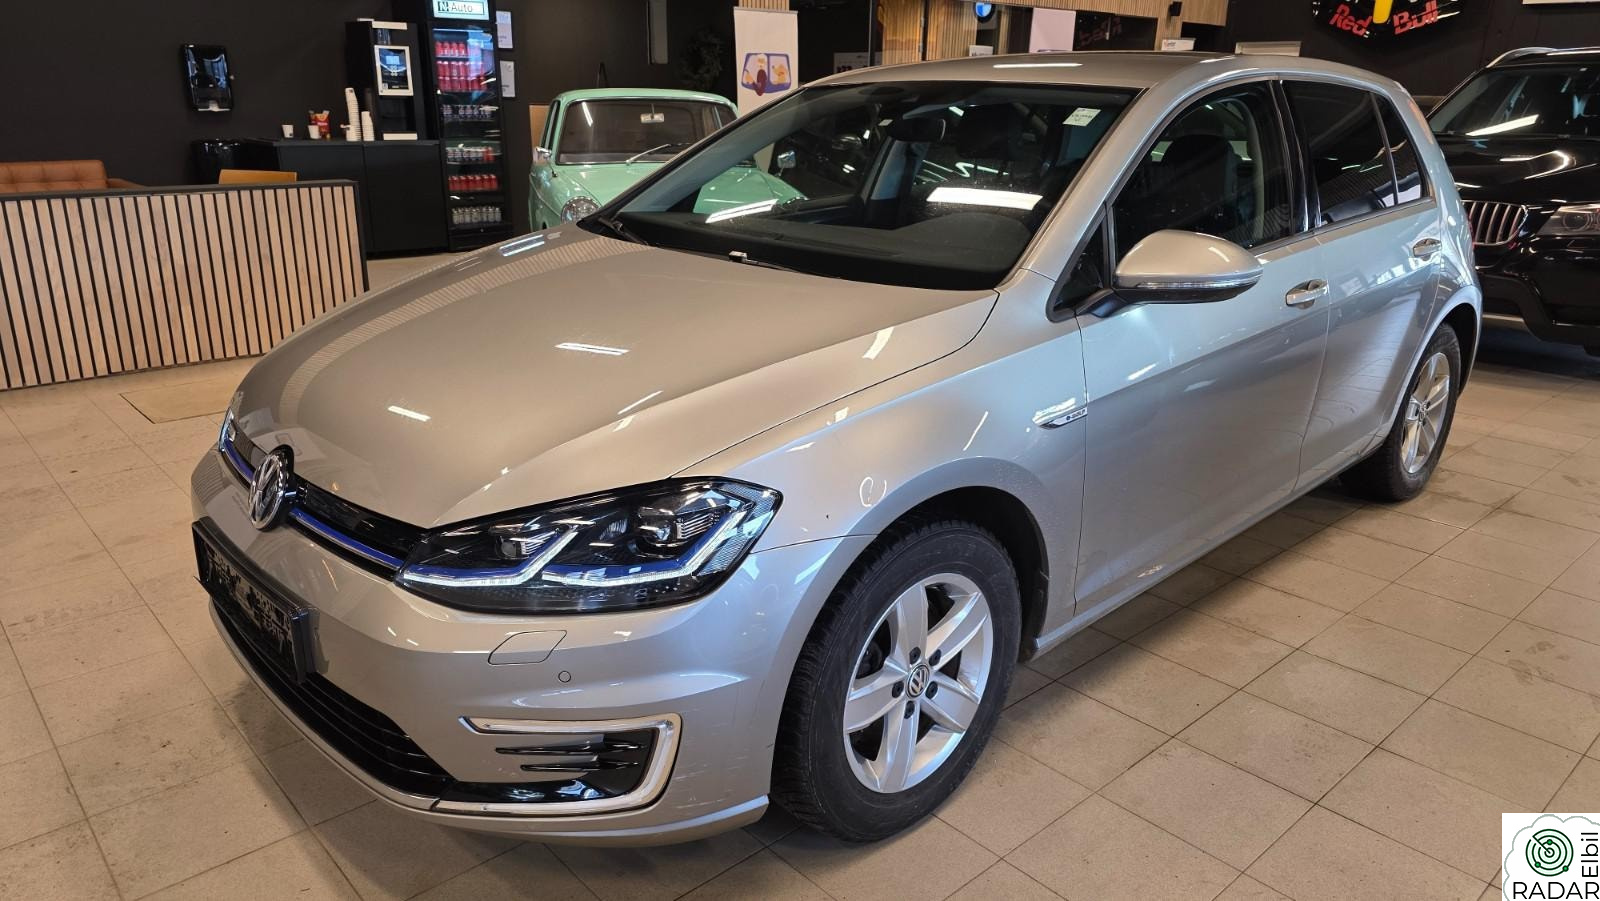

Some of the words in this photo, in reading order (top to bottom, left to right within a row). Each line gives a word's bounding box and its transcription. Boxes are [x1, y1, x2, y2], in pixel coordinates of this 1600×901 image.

[451, 2, 473, 13] Auto
[1329, 3, 1373, 37] Red
[1392, 0, 1439, 35] Bull
